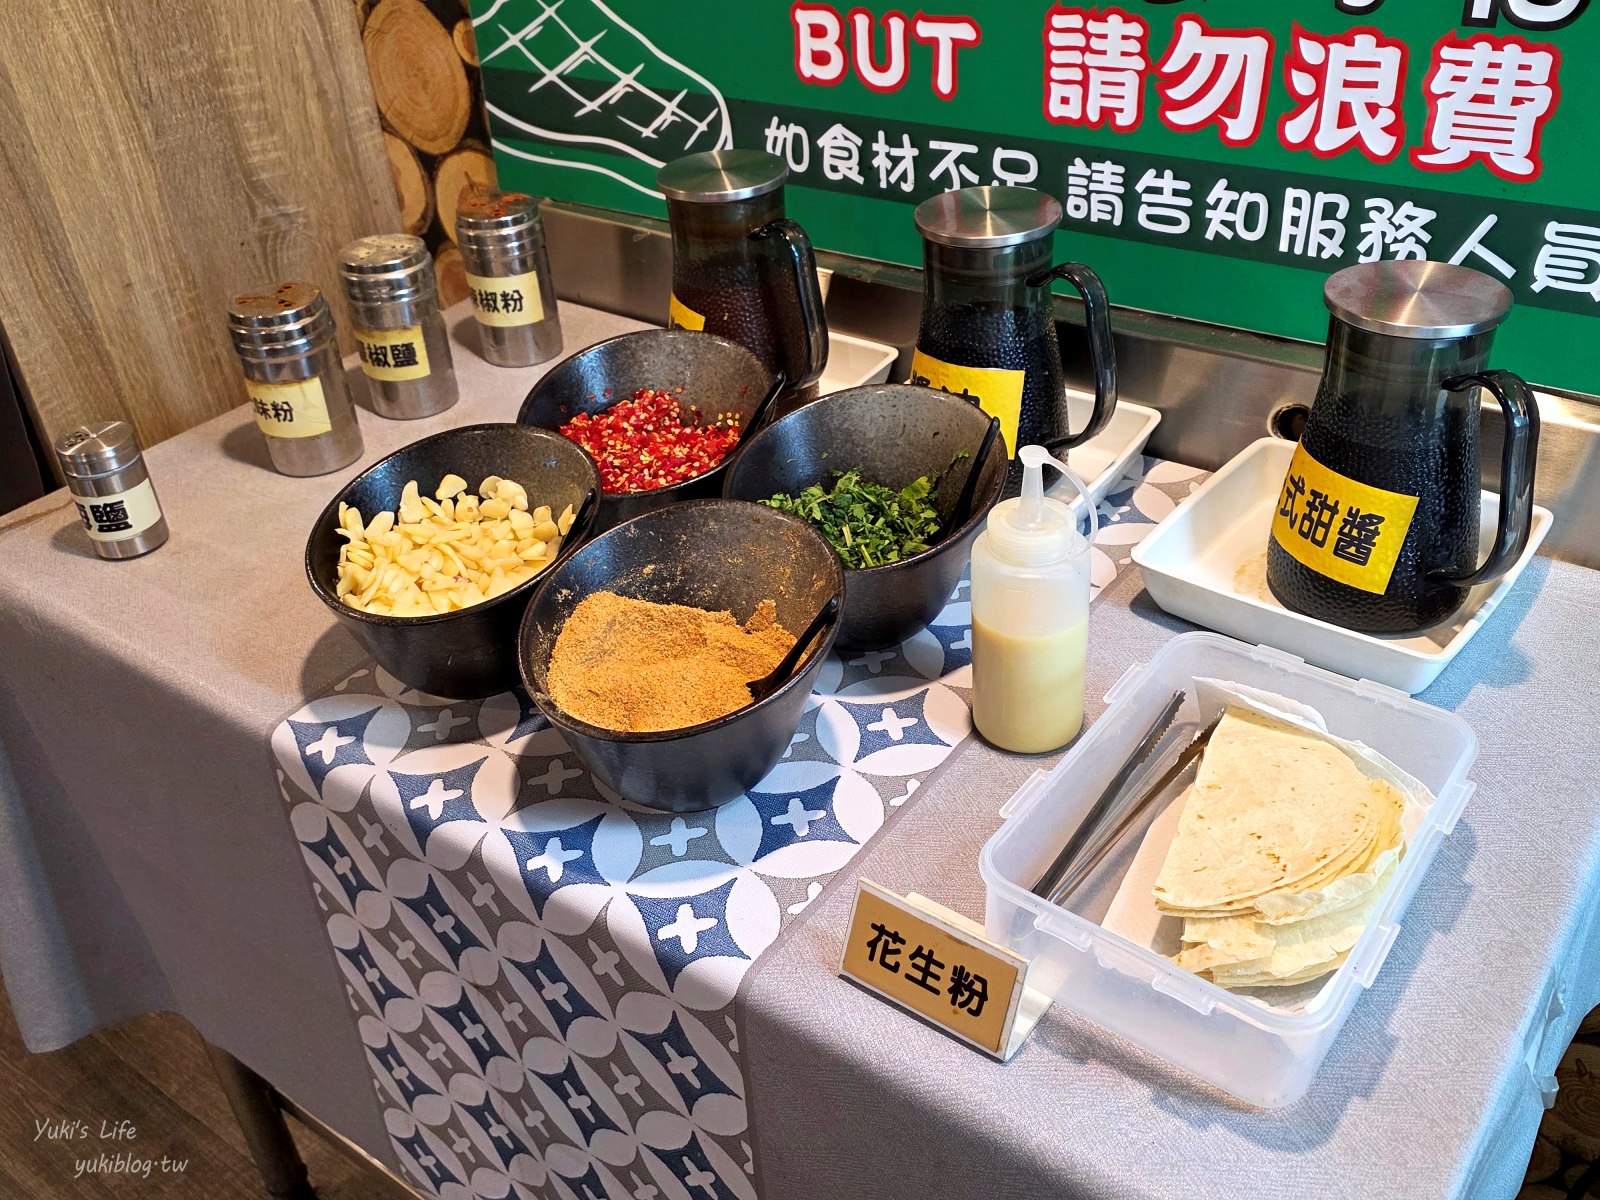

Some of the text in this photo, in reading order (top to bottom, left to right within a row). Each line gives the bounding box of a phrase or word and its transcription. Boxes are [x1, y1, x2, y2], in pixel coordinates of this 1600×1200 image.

[793, 6, 982, 98] BUT
[1046, 10, 1557, 178] 請勿浪費
[765, 115, 1600, 302] 如食材不足 請告知服務人員
[866, 922, 989, 1018] 花生粉
